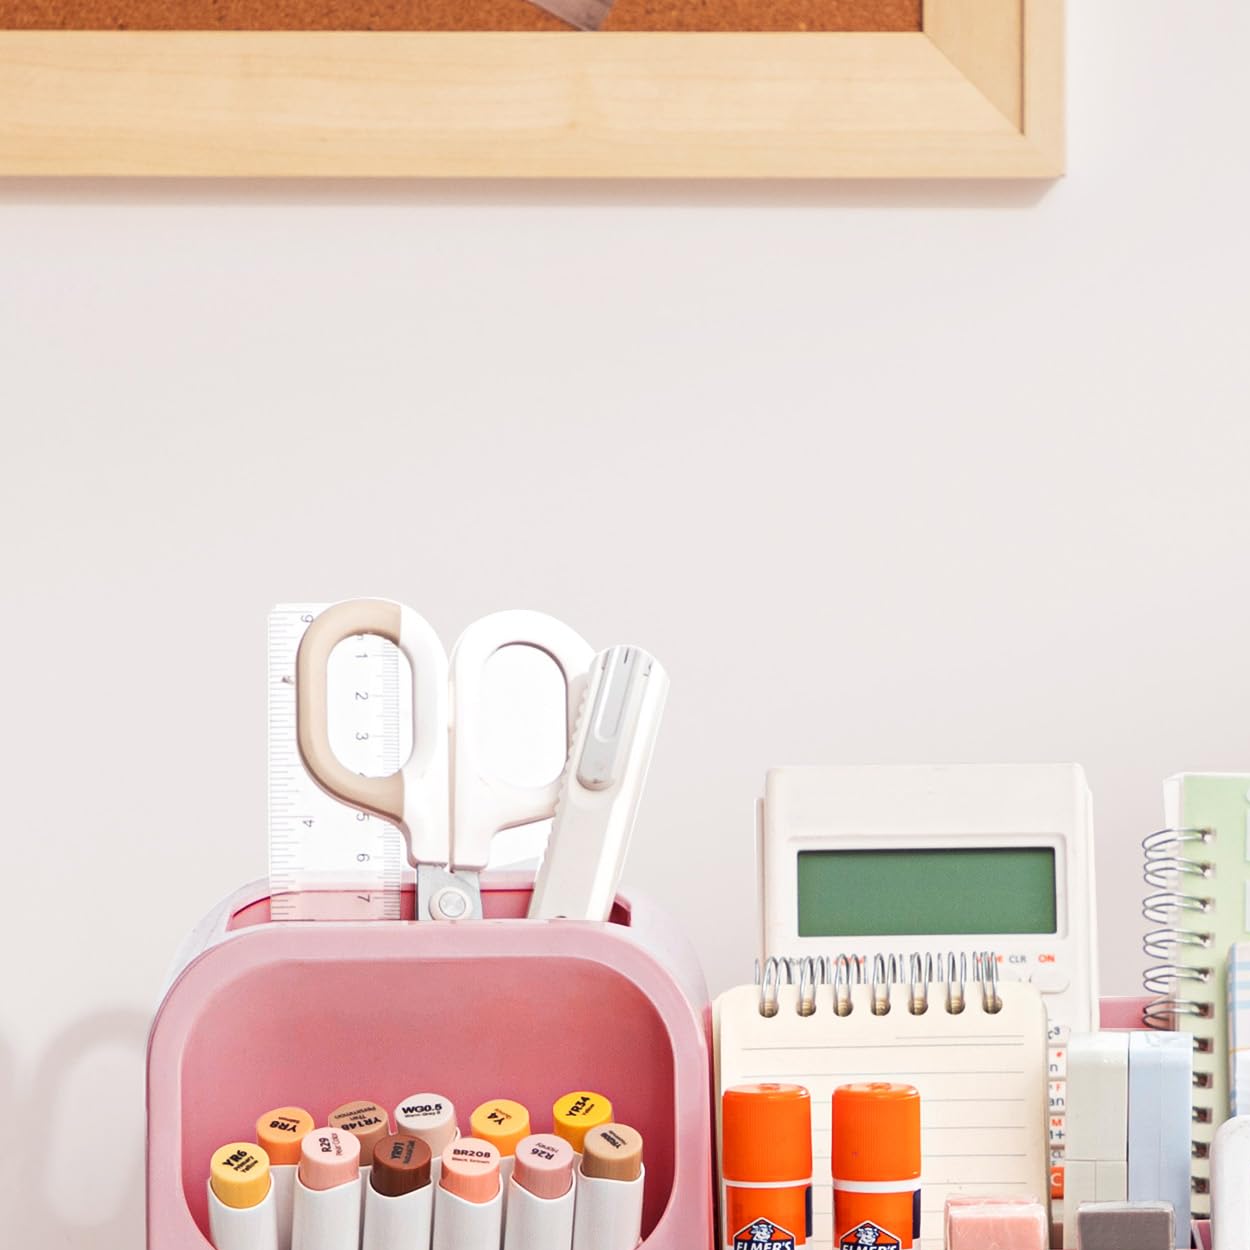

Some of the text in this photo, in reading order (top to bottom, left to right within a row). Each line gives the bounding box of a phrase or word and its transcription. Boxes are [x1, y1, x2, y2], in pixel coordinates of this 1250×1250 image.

[355, 691, 368, 701] 2
[355, 732, 369, 741] 3
[356, 853, 370, 862] 6
[358, 894, 371, 903] 7
[1008, 955, 1027, 963] CLR
[1038, 954, 1056, 963] ON
[401, 1103, 443, 1114] WG0.5
[565, 1096, 591, 1117] YR34
[487, 1112, 505, 1126] Y4
[269, 1120, 297, 1133] YR8
[318, 1137, 333, 1153] R29
[221, 1149, 248, 1167] YR6
[531, 1147, 555, 1160] R26
